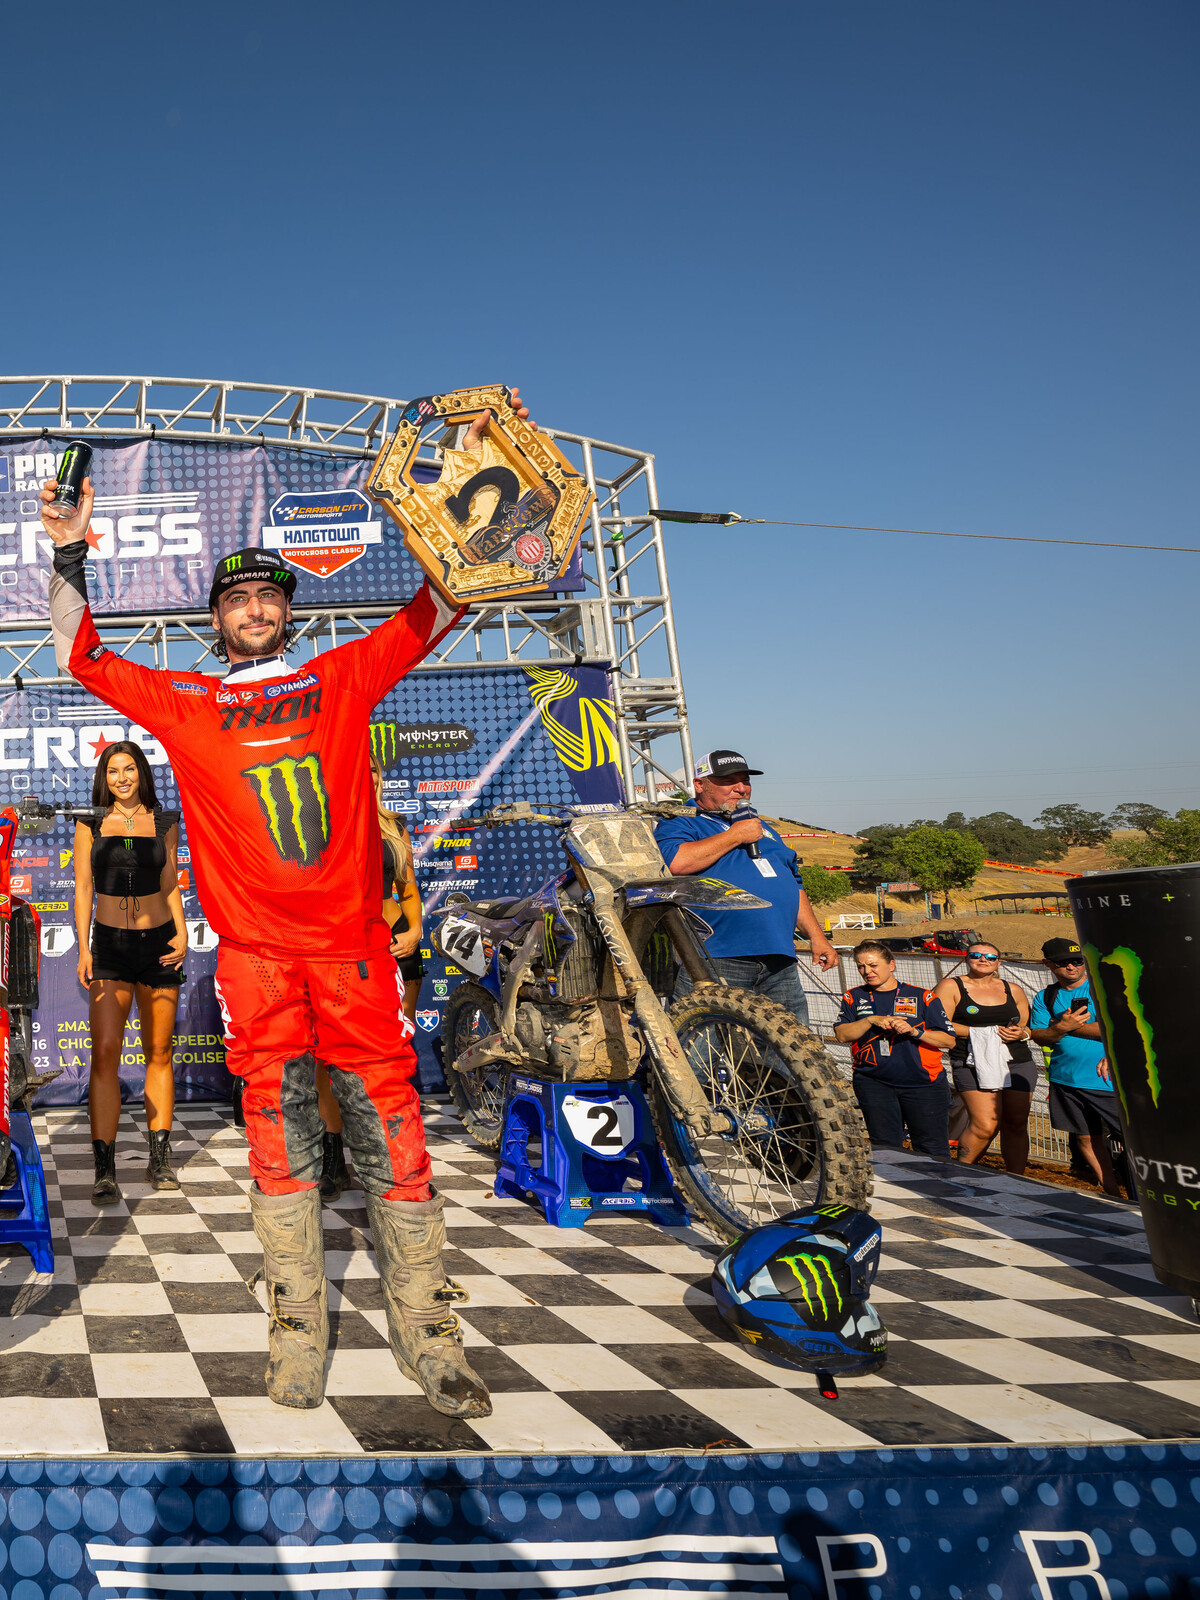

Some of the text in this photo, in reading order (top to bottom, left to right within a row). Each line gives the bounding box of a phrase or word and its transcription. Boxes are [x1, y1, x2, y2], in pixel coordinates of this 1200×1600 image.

[507, 420, 550, 469] 2023
[296, 511, 343, 519] MOTORSPORTS
[299, 503, 366, 515] CARSON CITY
[283, 527, 361, 544] HANGTOWN
[284, 546, 362, 557] MOTOCROSS CLASSIC
[233, 571, 271, 581] YAMAHA
[280, 675, 317, 692] YAMAHA
[219, 688, 322, 731] THOR
[399, 728, 469, 742] MONSTER
[443, 838, 472, 848] THOR
[420, 860, 452, 868] Husqvarna
[428, 879, 479, 888] DUNLOP
[32, 902, 67, 911] ACERBIS
[445, 925, 482, 961] 14
[422, 1016, 435, 1028] X
[33, 1039, 47, 1050] 16
[33, 1056, 50, 1068] 23
[59, 1055, 86, 1067] L.A.
[173, 1052, 225, 1064] COLISE
[586, 1105, 623, 1147] 2
[853, 1233, 880, 1262] apdesigns
[803, 1338, 836, 1354] BELL
